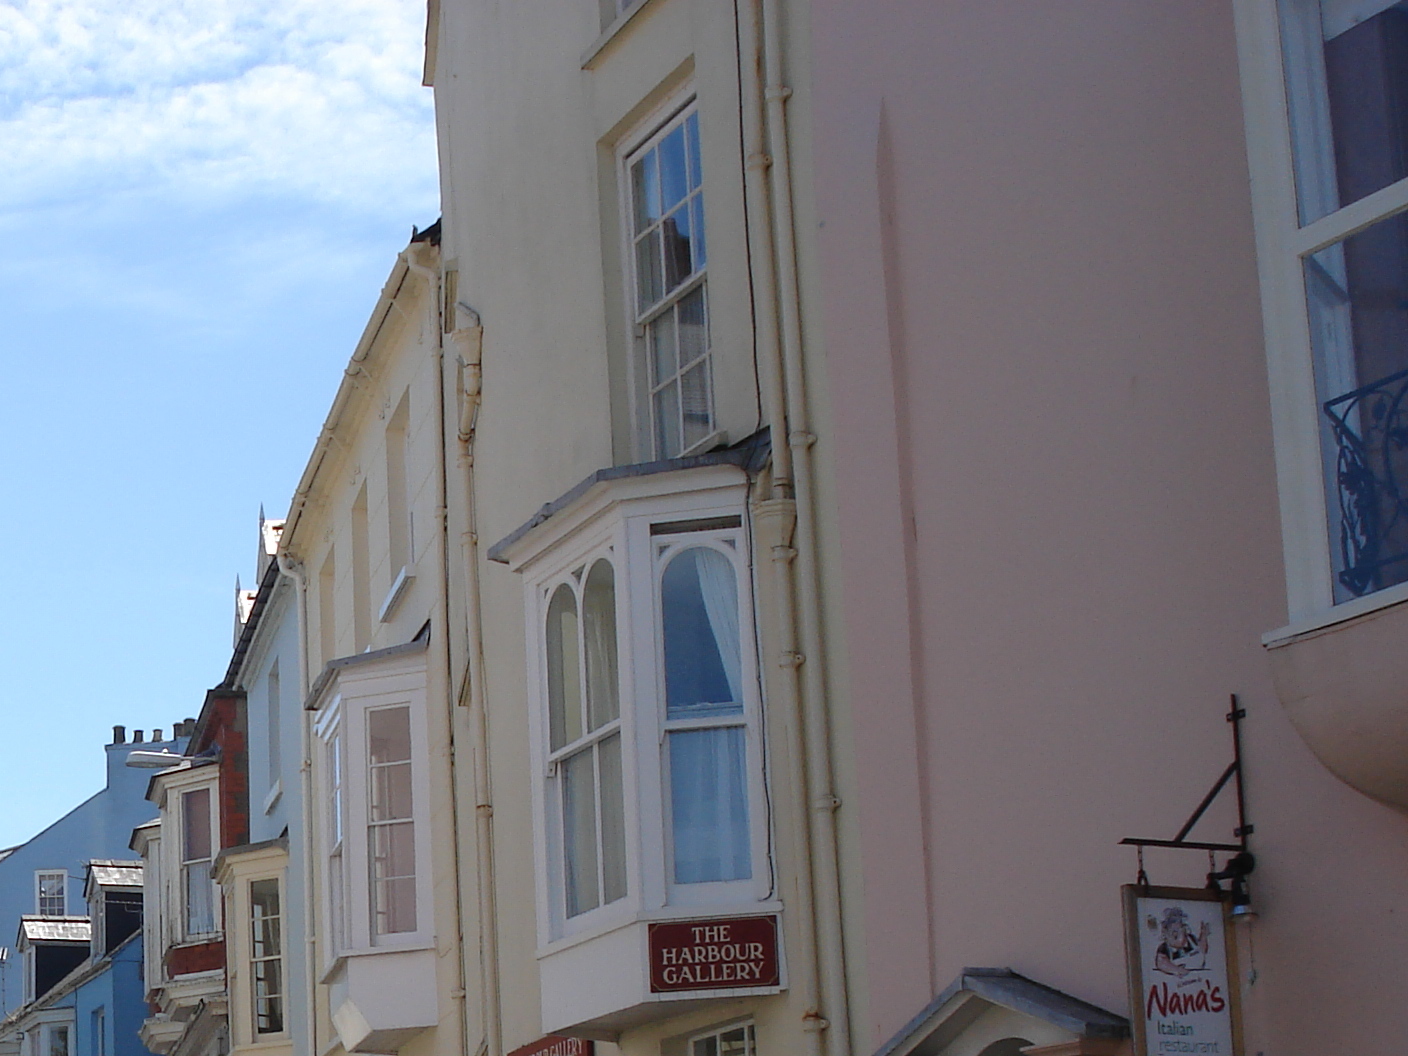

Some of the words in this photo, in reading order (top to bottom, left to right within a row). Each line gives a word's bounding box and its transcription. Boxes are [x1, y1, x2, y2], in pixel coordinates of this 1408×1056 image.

[691, 925, 731, 944] THE
[662, 942, 765, 965] HARBOUR
[662, 961, 764, 984] GALLERY
[1146, 979, 1225, 1020] Nana's
[1157, 1020, 1194, 1036] Italian
[1159, 1040, 1220, 1054] restaurant
